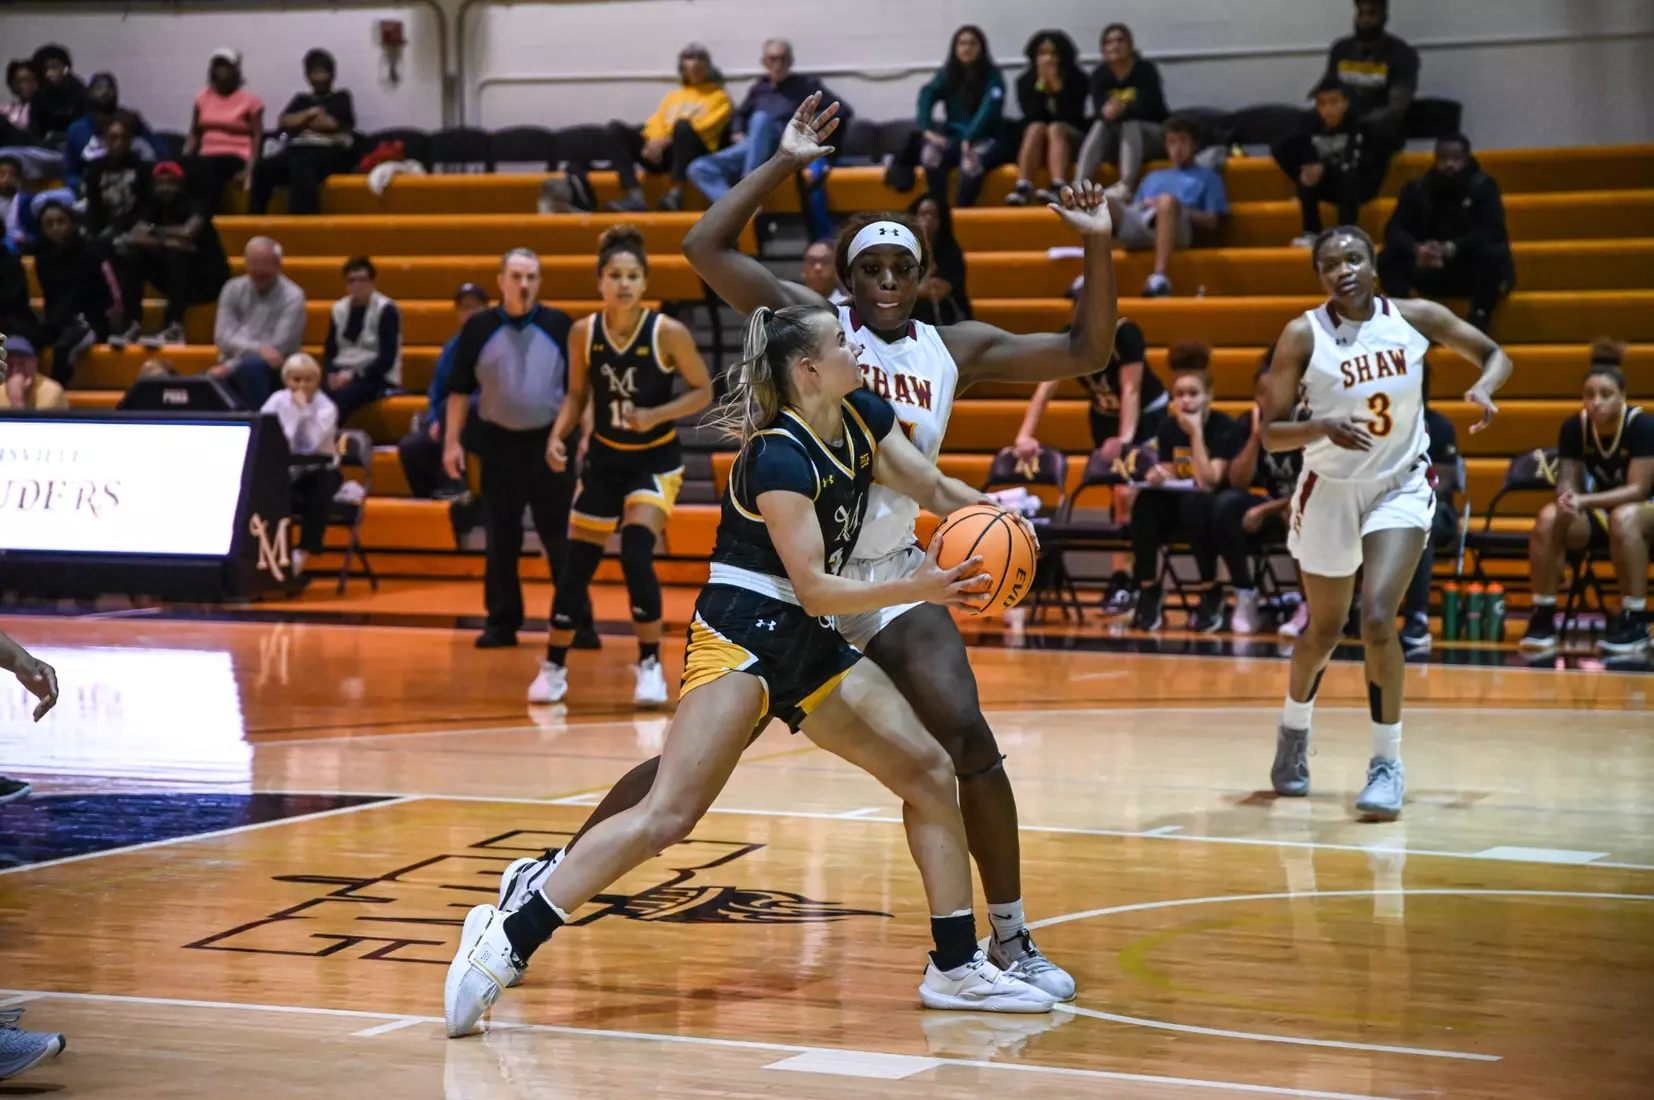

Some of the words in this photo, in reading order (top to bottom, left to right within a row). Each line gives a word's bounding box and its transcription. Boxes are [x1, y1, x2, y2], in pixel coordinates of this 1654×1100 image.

[857, 363, 932, 412] SHAW
[1340, 348, 1408, 389] SHAW
[1366, 391, 1394, 438] 3
